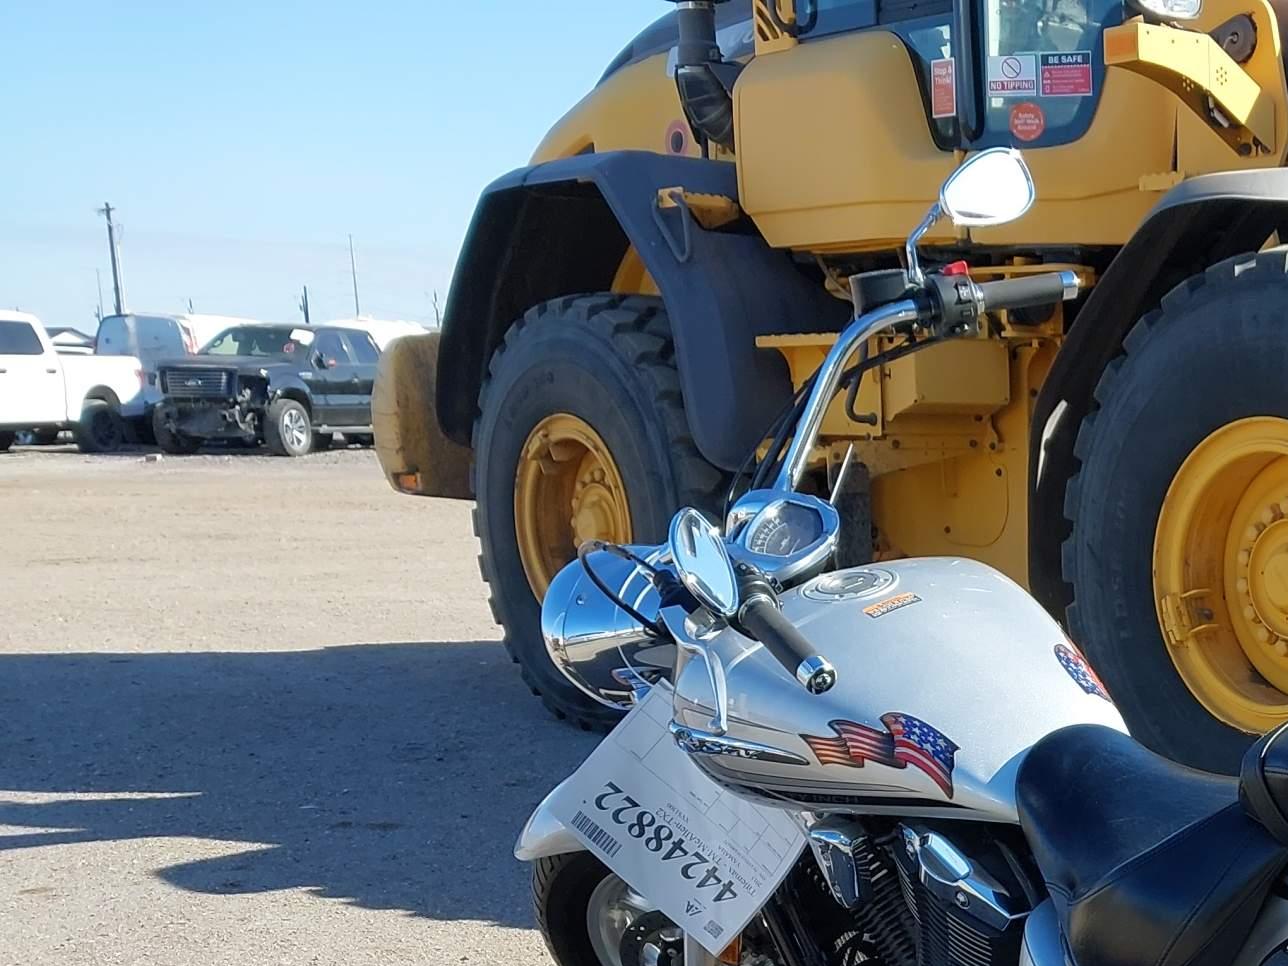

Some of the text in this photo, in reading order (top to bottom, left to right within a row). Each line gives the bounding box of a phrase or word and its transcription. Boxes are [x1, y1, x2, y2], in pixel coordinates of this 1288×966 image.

[1048, 55, 1083, 64] BE SAFE
[990, 81, 1034, 90] NO TIPPING
[594, 781, 738, 903] 44248822
